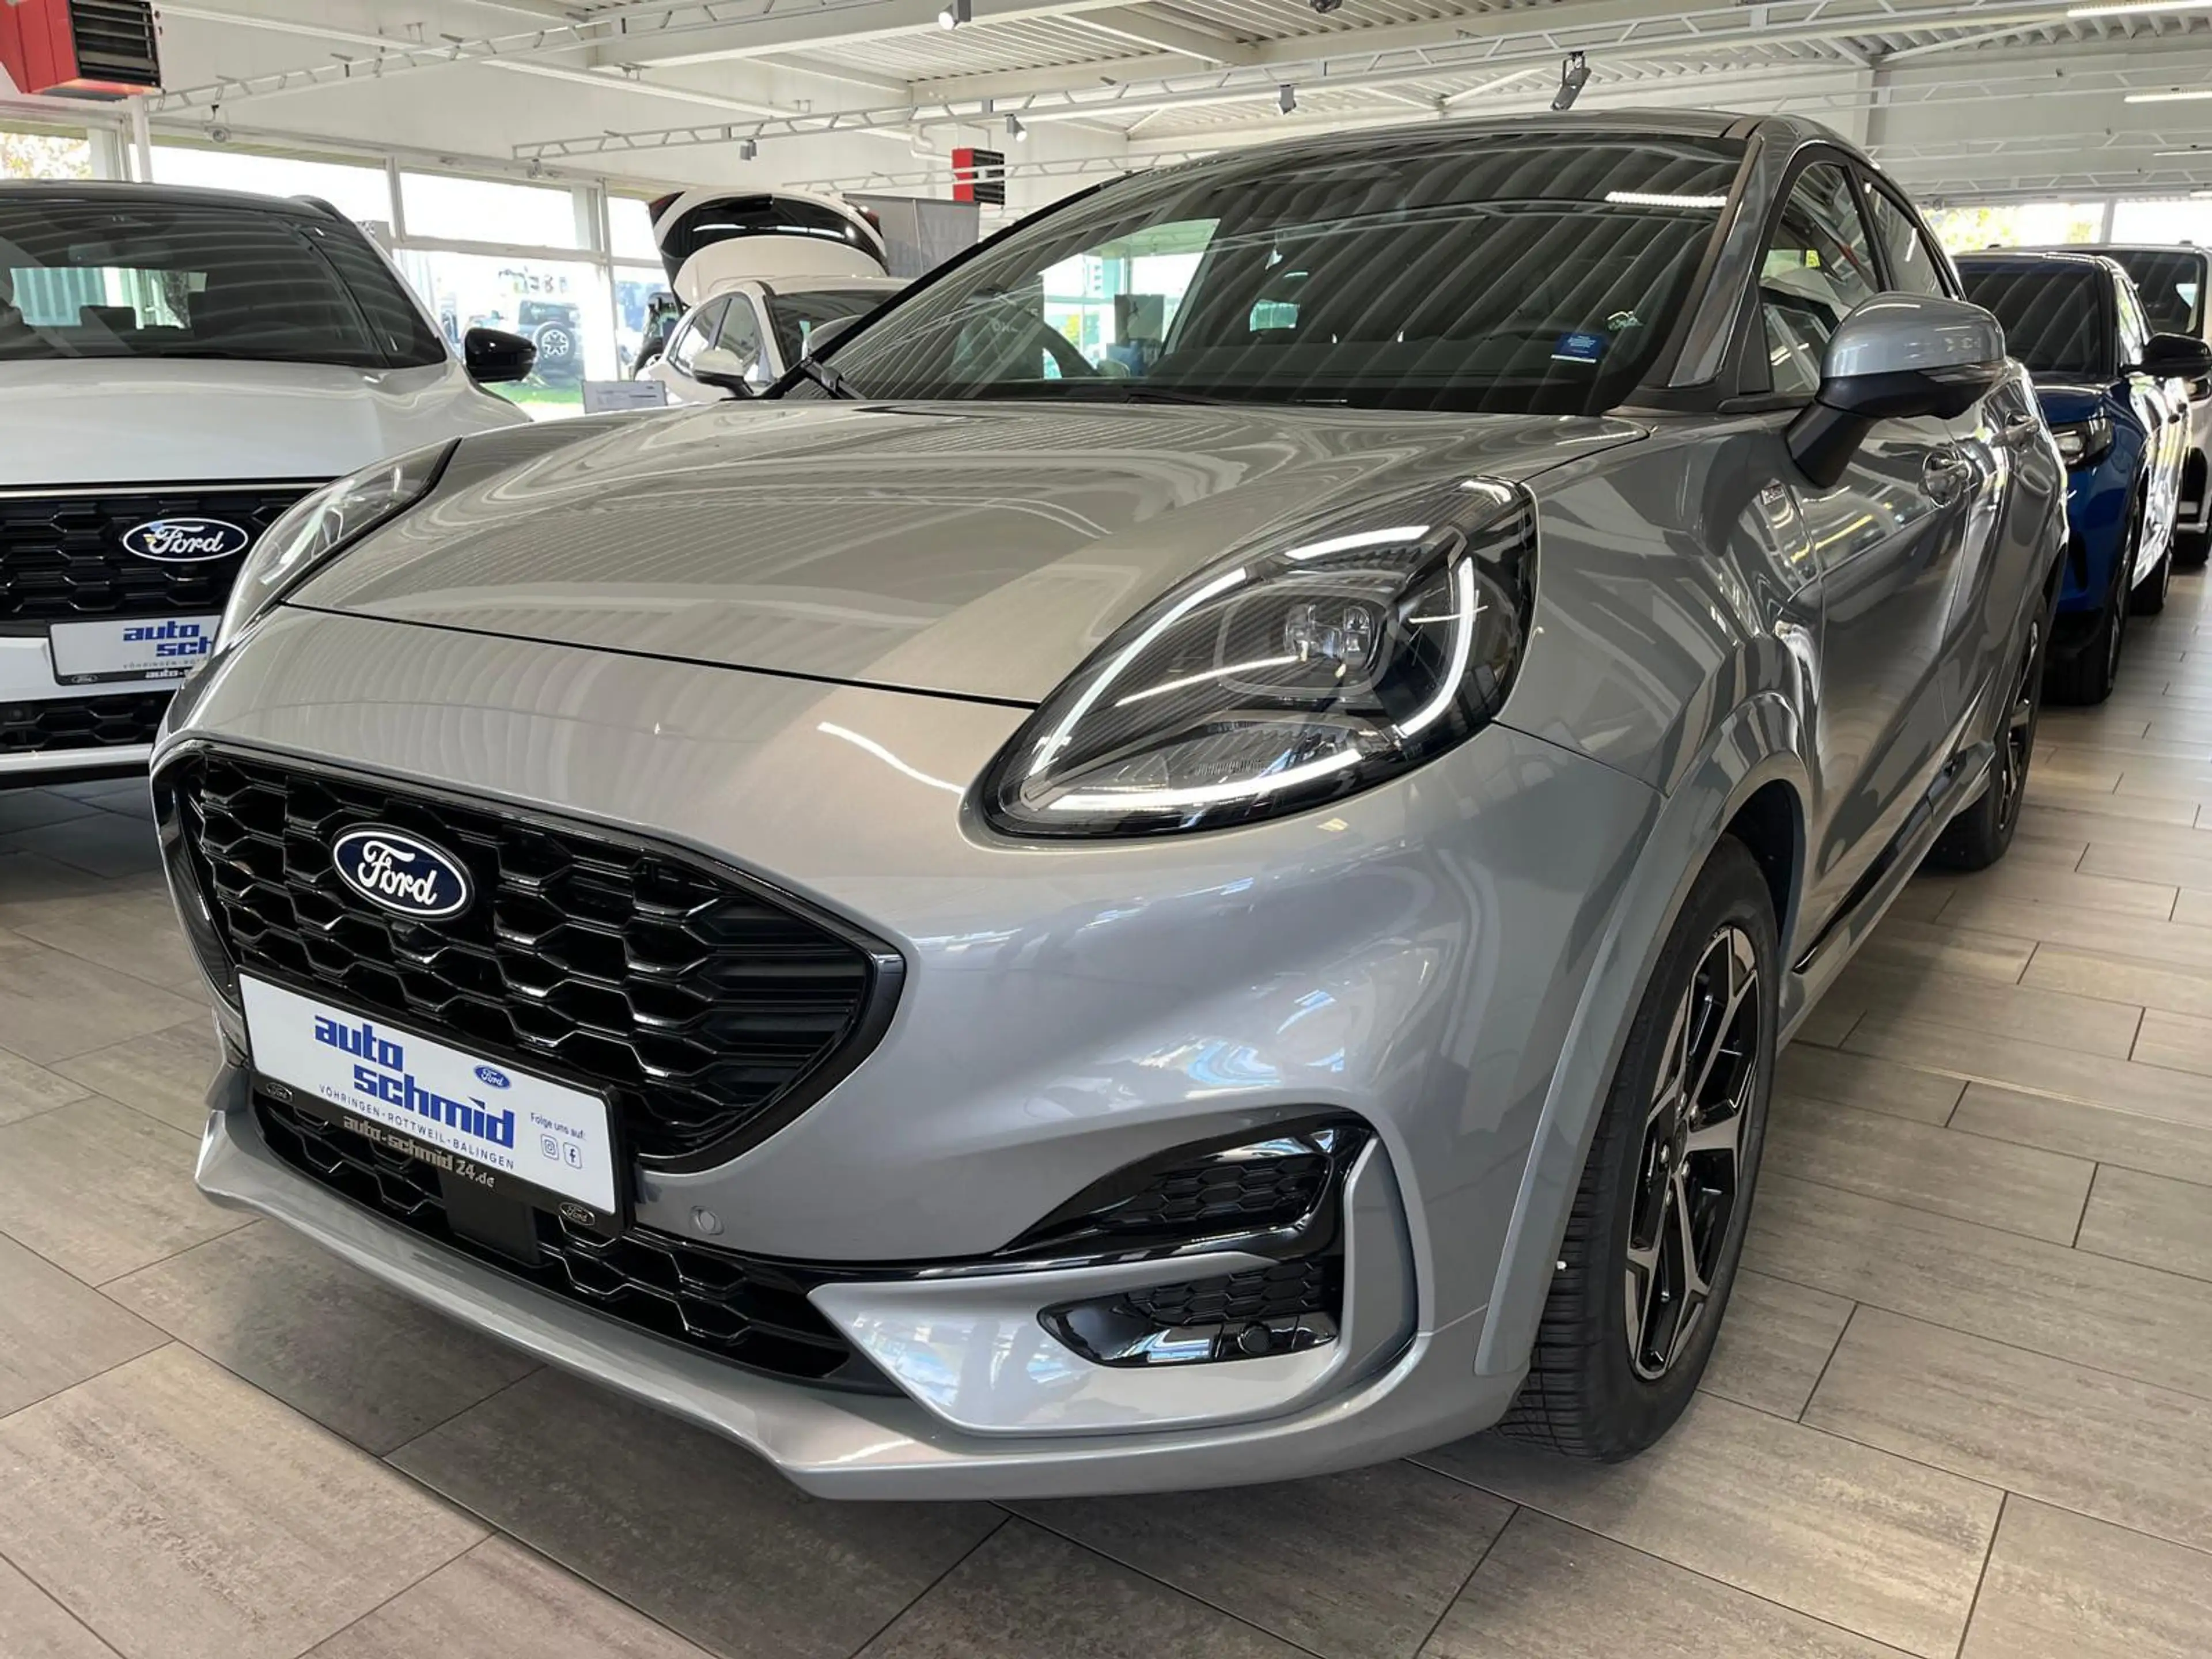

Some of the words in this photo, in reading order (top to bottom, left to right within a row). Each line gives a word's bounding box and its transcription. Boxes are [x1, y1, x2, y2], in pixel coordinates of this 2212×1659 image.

[147, 525, 224, 554] Ford
[123, 620, 200, 641] auto
[357, 840, 438, 906] Ford
[315, 1014, 403, 1073] auto
[479, 1066, 505, 1086] Ford
[353, 1063, 514, 1149] schmid
[530, 1112, 552, 1129] Folge
